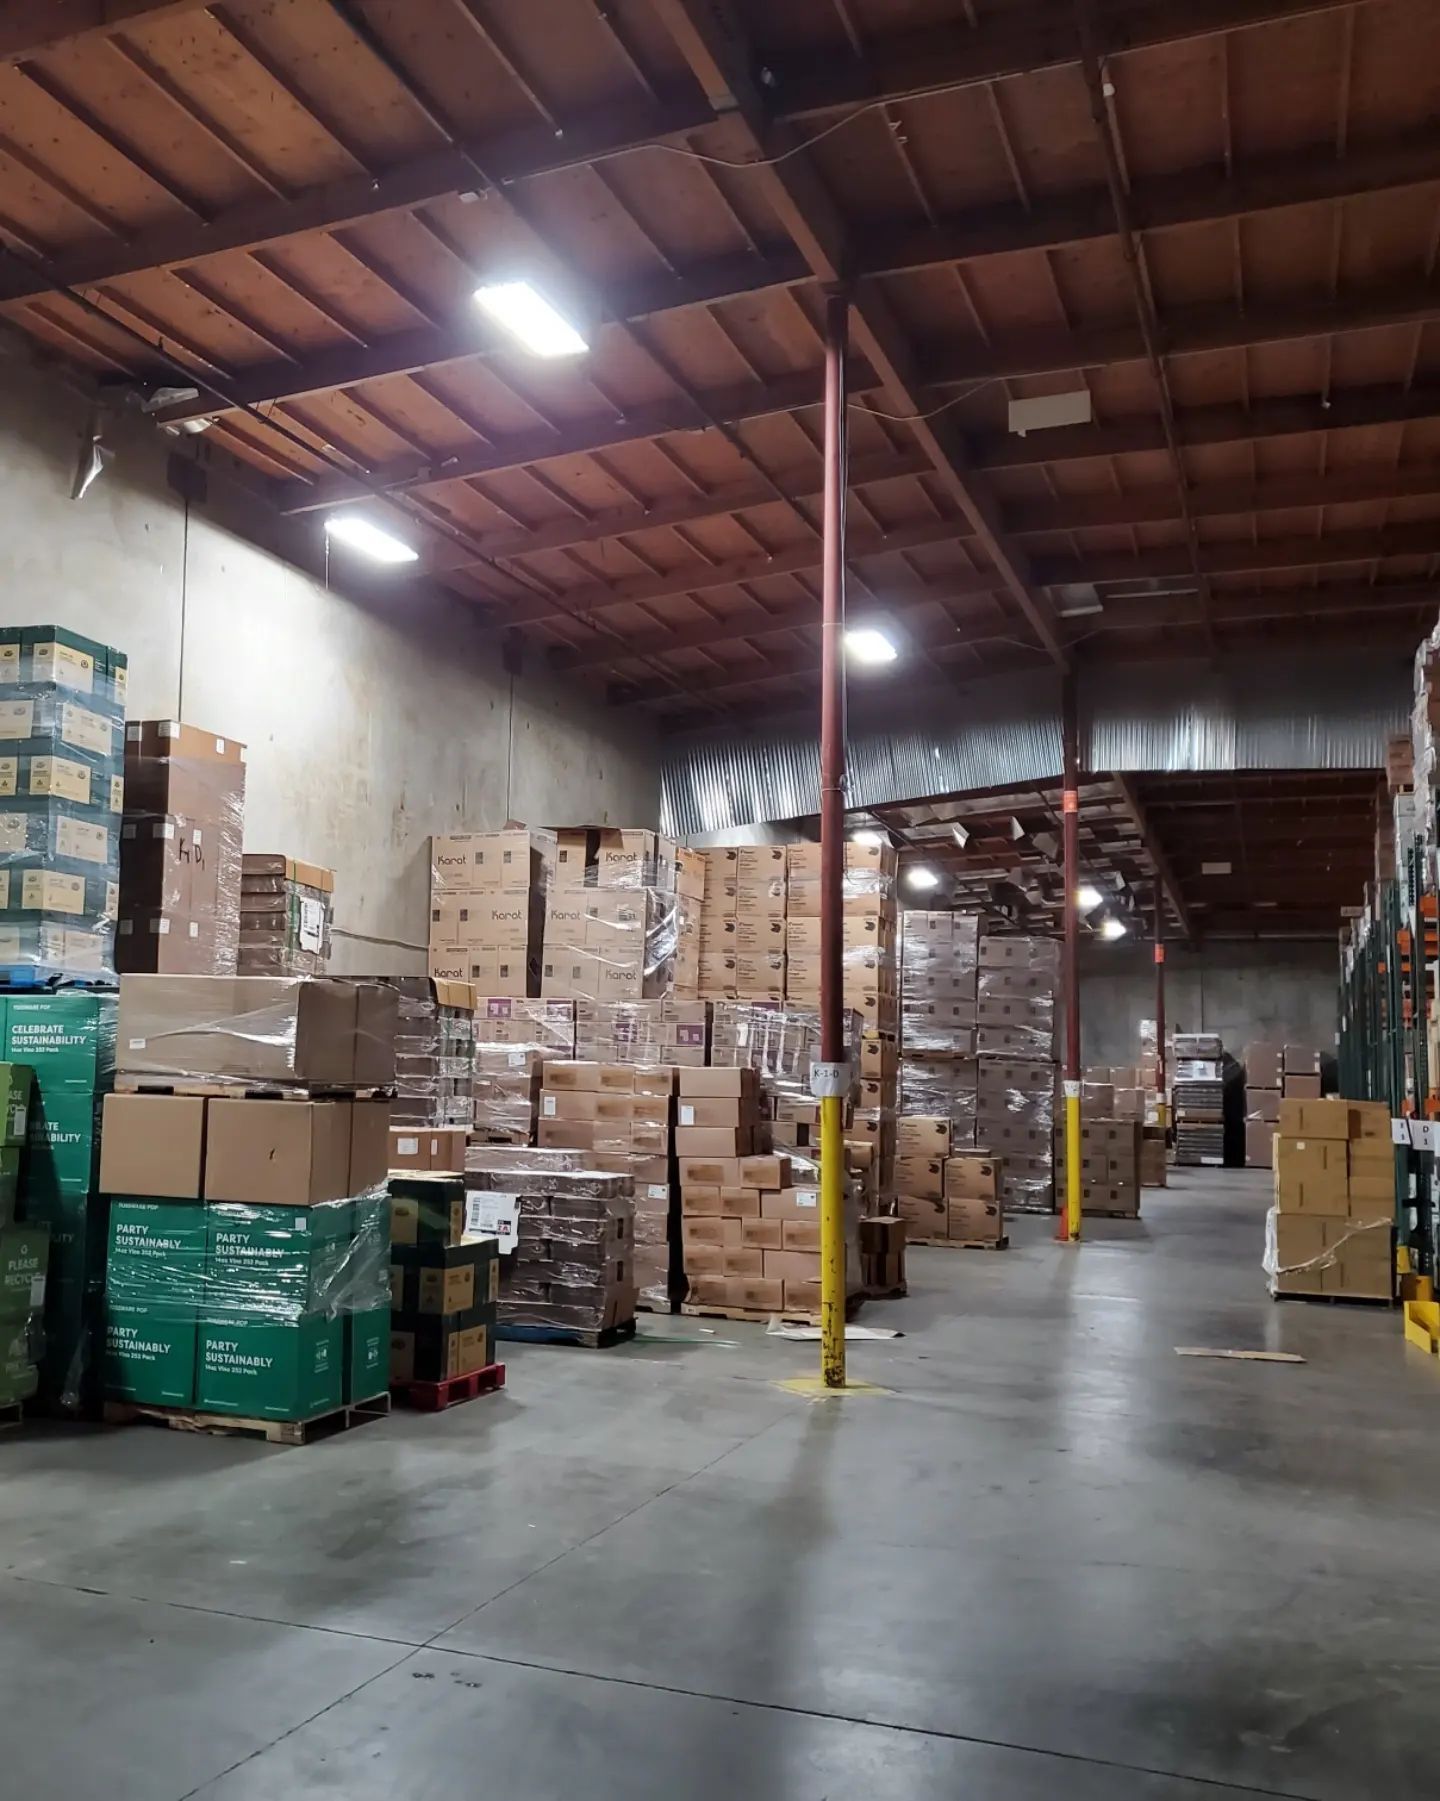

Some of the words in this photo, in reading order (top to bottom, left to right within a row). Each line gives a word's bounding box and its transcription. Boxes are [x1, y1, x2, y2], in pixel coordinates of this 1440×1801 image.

[438, 853, 466, 865] Karat
[606, 852, 638, 861] Karat
[492, 910, 521, 920] Karat
[551, 910, 580, 920] Karat
[434, 968, 464, 977] Karat
[606, 970, 636, 980] Karat
[12, 1024, 64, 1034] CELEBRATE
[12, 1036, 86, 1045] SUSTAINABILITY
[814, 1069, 840, 1078] K-1-D
[116, 1224, 149, 1234] PARTY
[115, 1236, 181, 1249] SUSTAINABLY
[216, 1233, 250, 1244] PARTY
[216, 1245, 284, 1258] SUSTAINABLY
[8, 1258, 38, 1271] PLEASE
[107, 1326, 138, 1338] PARTY
[106, 1338, 171, 1354] SUSTAINABLY
[206, 1340, 238, 1352] PARTY
[205, 1352, 273, 1368] SUSTAINABLY
